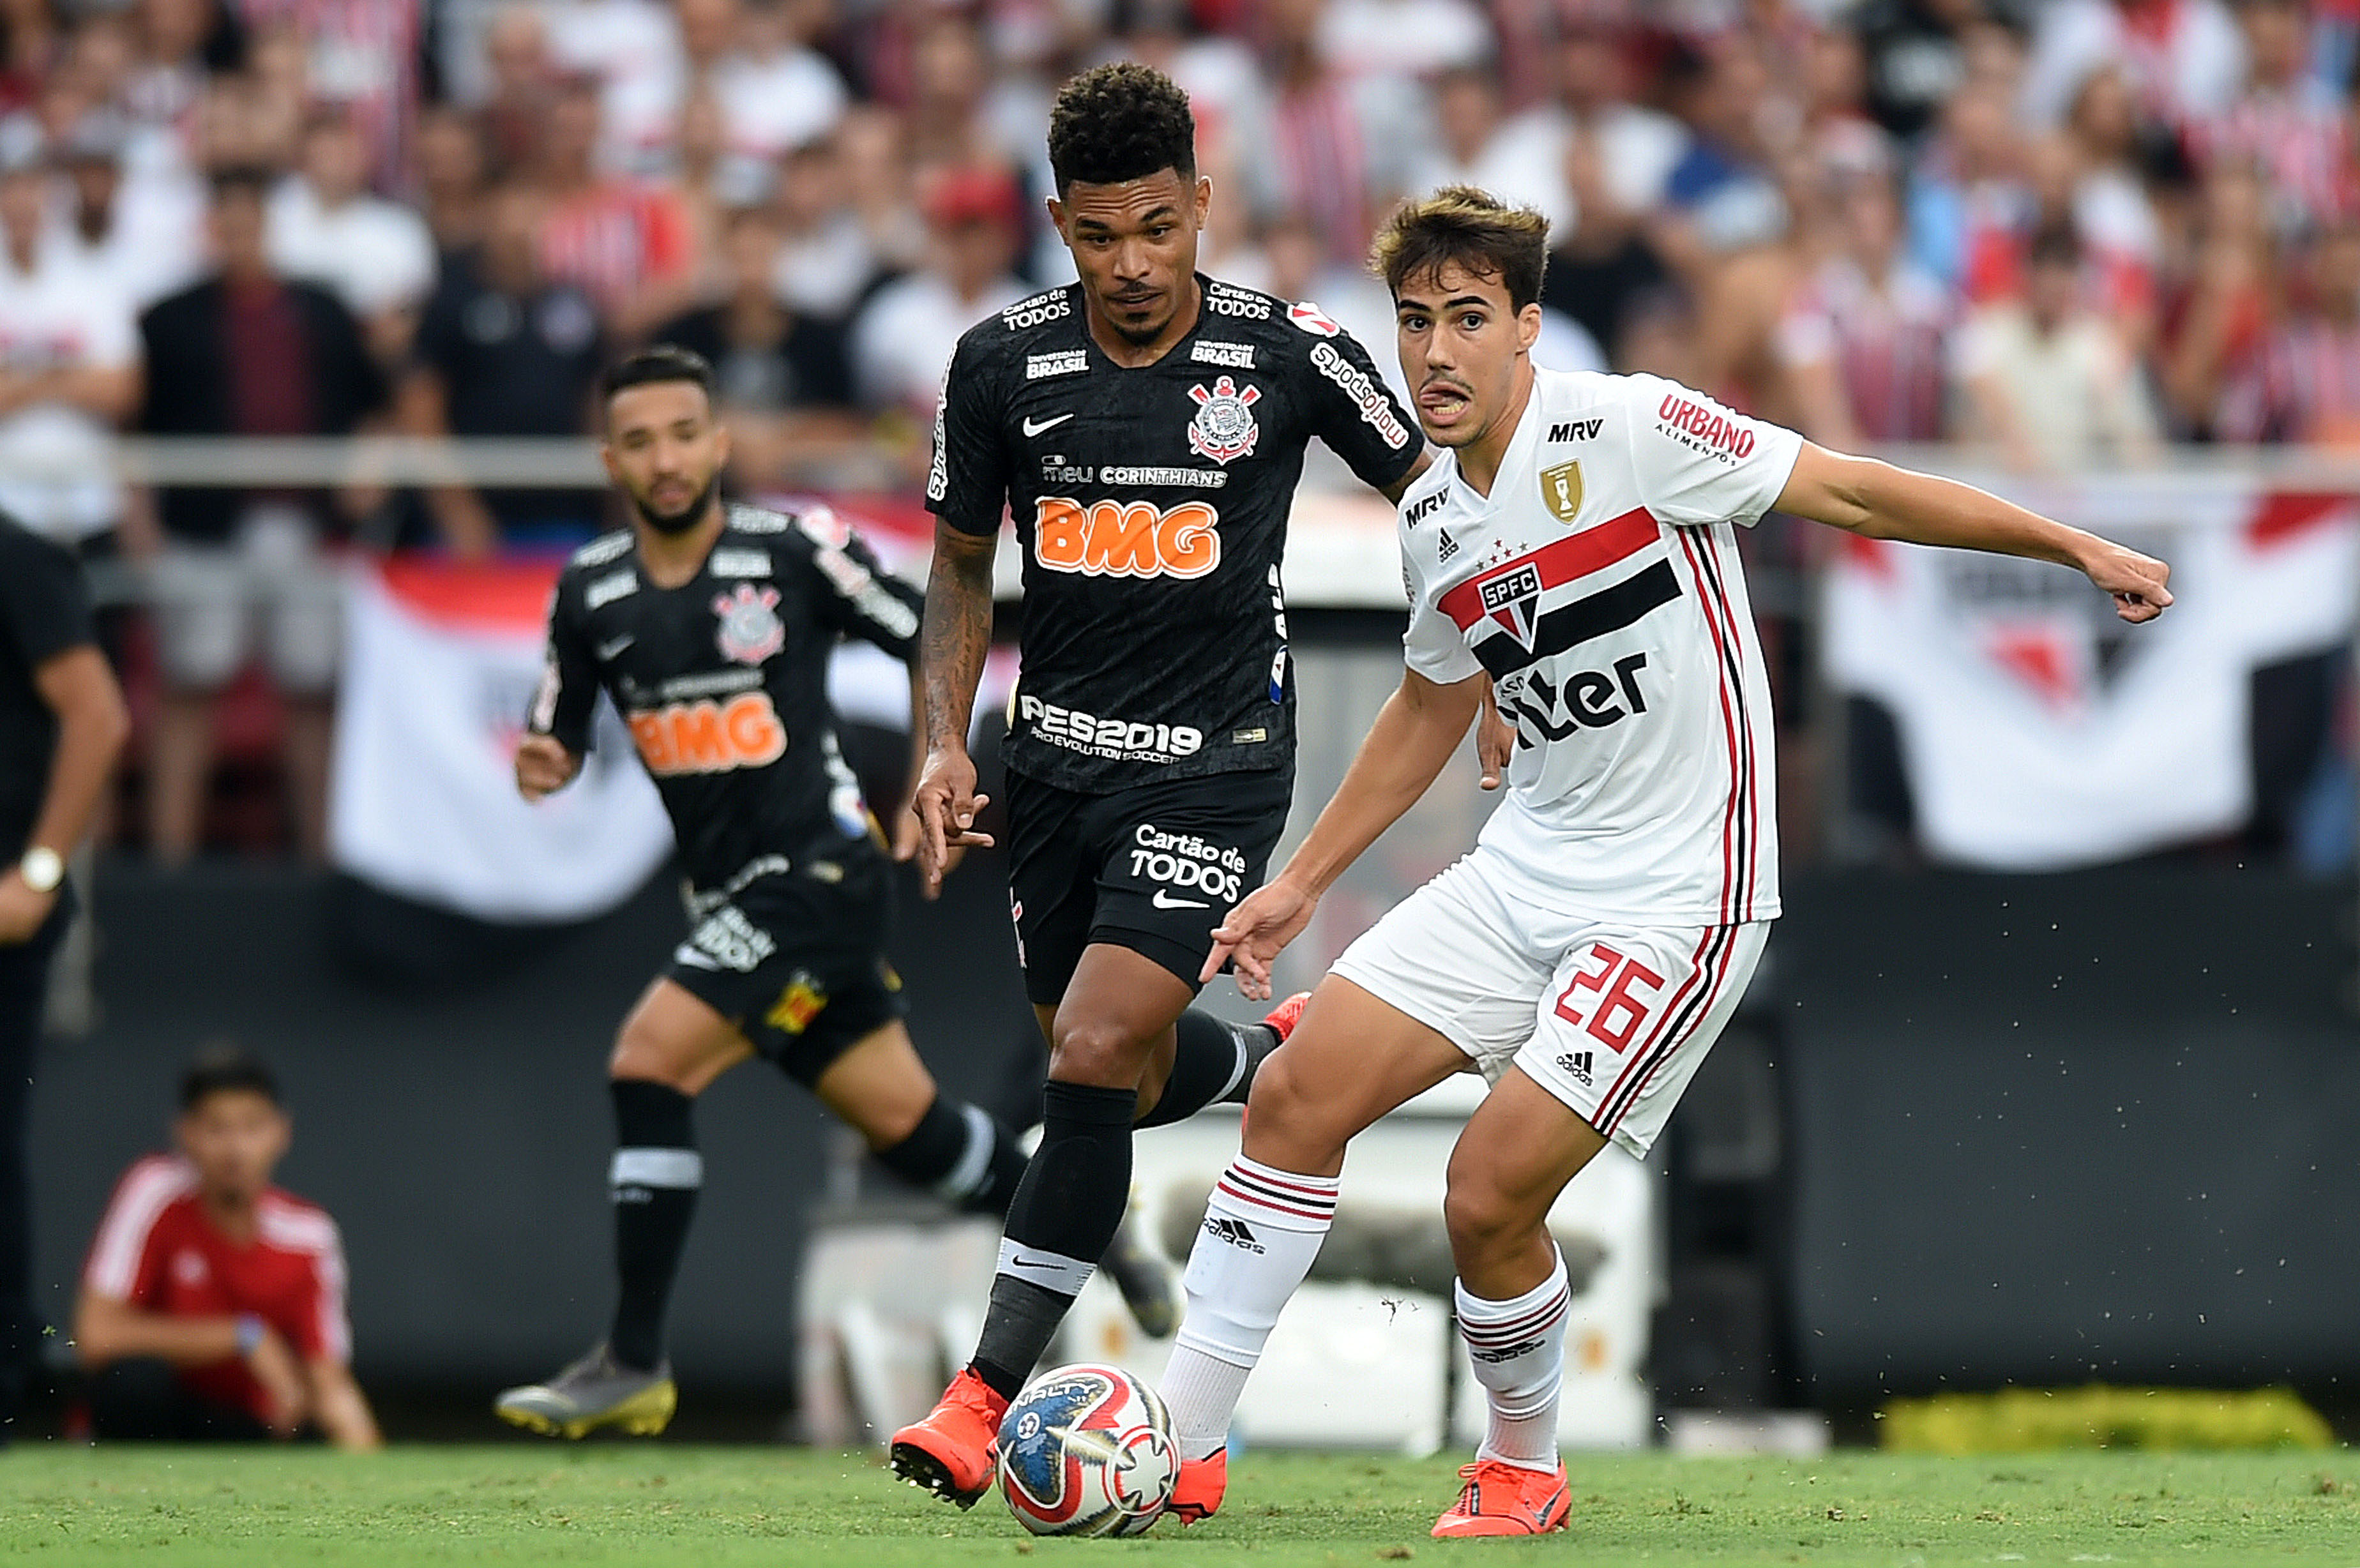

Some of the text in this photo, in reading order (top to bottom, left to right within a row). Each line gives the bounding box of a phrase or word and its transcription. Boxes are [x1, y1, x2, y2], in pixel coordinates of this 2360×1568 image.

[1049, 289, 1067, 301] de
[1207, 296, 1271, 320] TODOS
[1003, 301, 1071, 331] TODOS
[1026, 357, 1089, 379] BRASIL
[1190, 347, 1256, 369] BRASIL
[1312, 343, 1409, 448] marjosports
[1548, 419, 1604, 442] MRV
[1655, 423, 1736, 466] ALIMENTOS
[1659, 394, 1755, 458] URBANO
[1100, 467, 1228, 488] CORINTHIANS
[1406, 485, 1450, 530] MRV
[1034, 496, 1221, 580] BMG
[1485, 573, 1534, 606] SPFC
[629, 691, 788, 776] BMG
[1020, 695, 1202, 756] PES2019
[1031, 726, 1054, 743] PRO
[1054, 735, 1121, 760] EVOLUTION
[1136, 824, 1245, 873] Cartão de
[1131, 850, 1241, 903] TODOS
[1554, 943, 1665, 1055] 26
[1556, 1055, 1594, 1087] adidas
[1203, 1217, 1266, 1255] adidas
